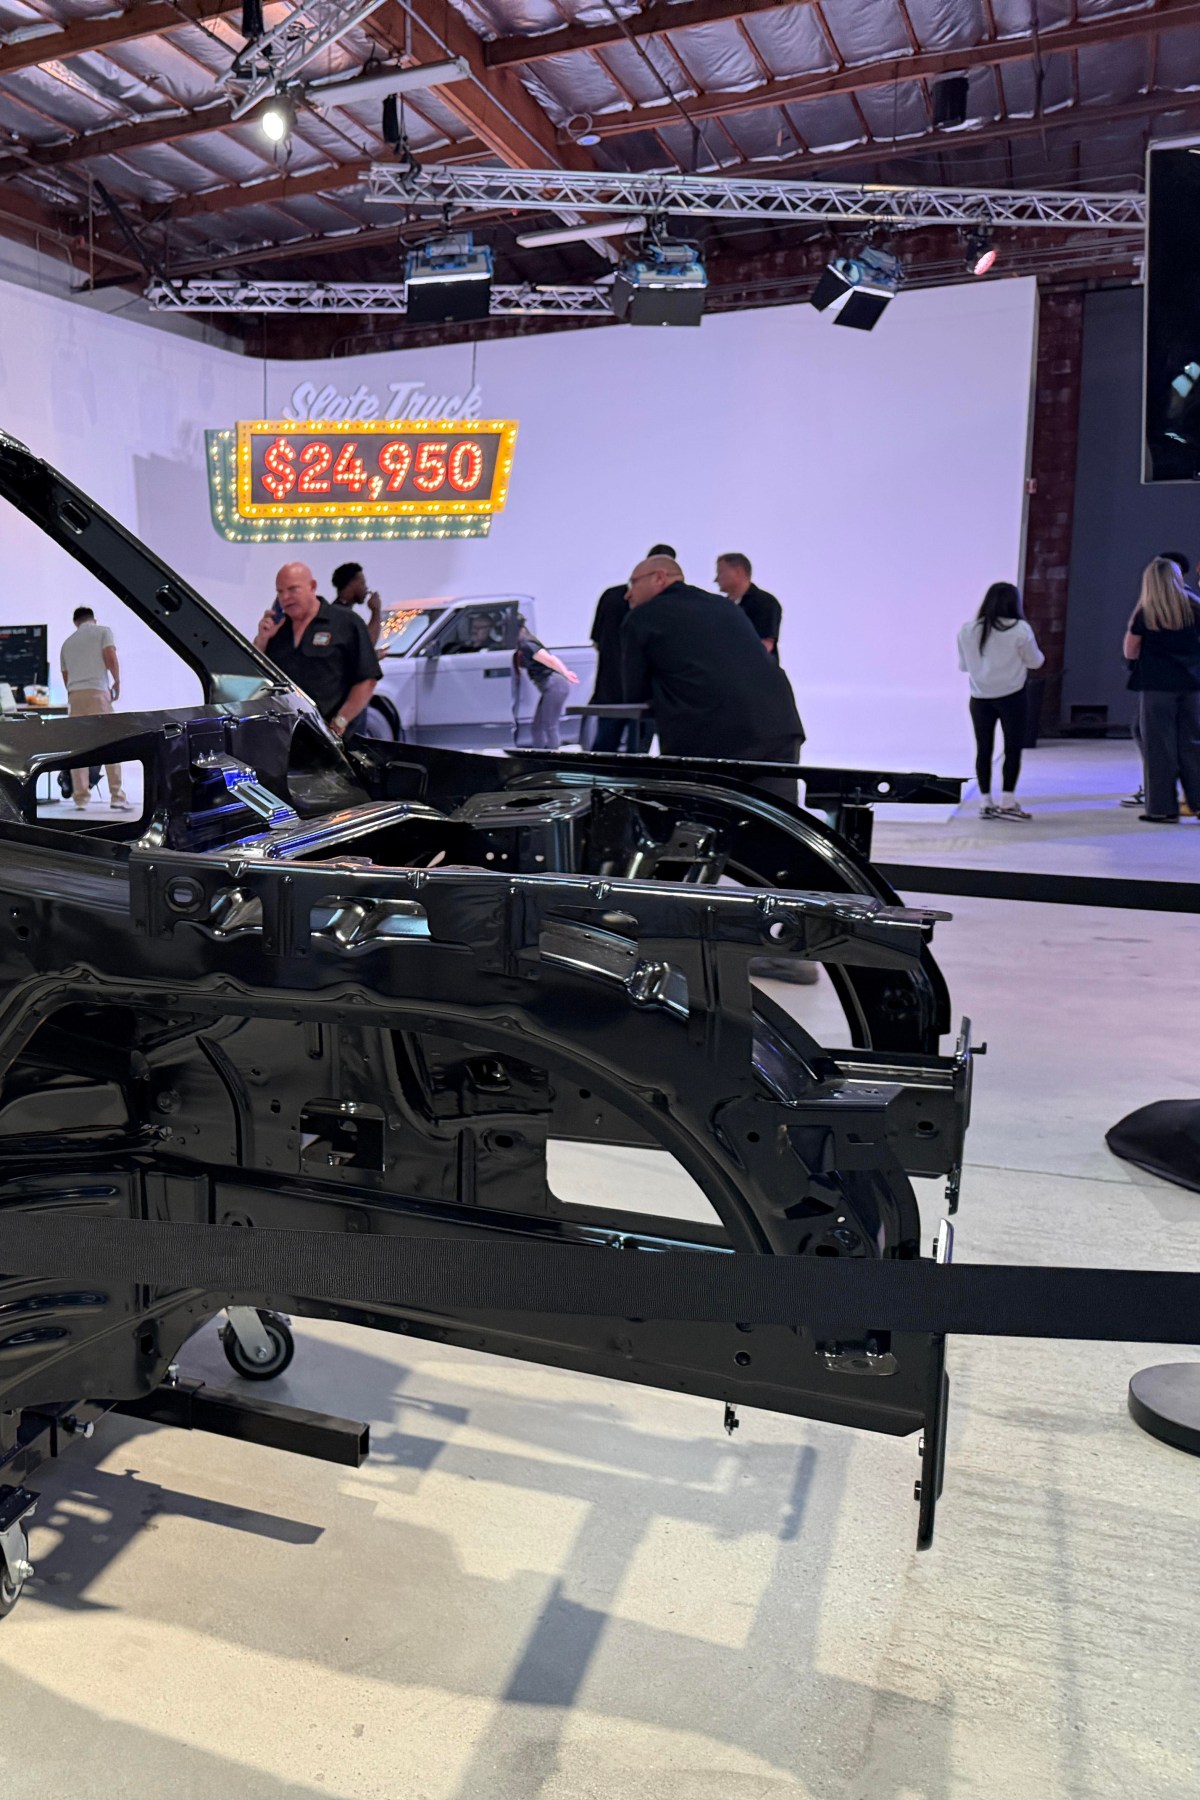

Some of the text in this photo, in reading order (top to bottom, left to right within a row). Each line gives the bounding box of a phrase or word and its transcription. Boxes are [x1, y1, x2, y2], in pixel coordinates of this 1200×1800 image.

[284, 382, 482, 421] Slate Truck
[262, 437, 483, 500] $24,950
